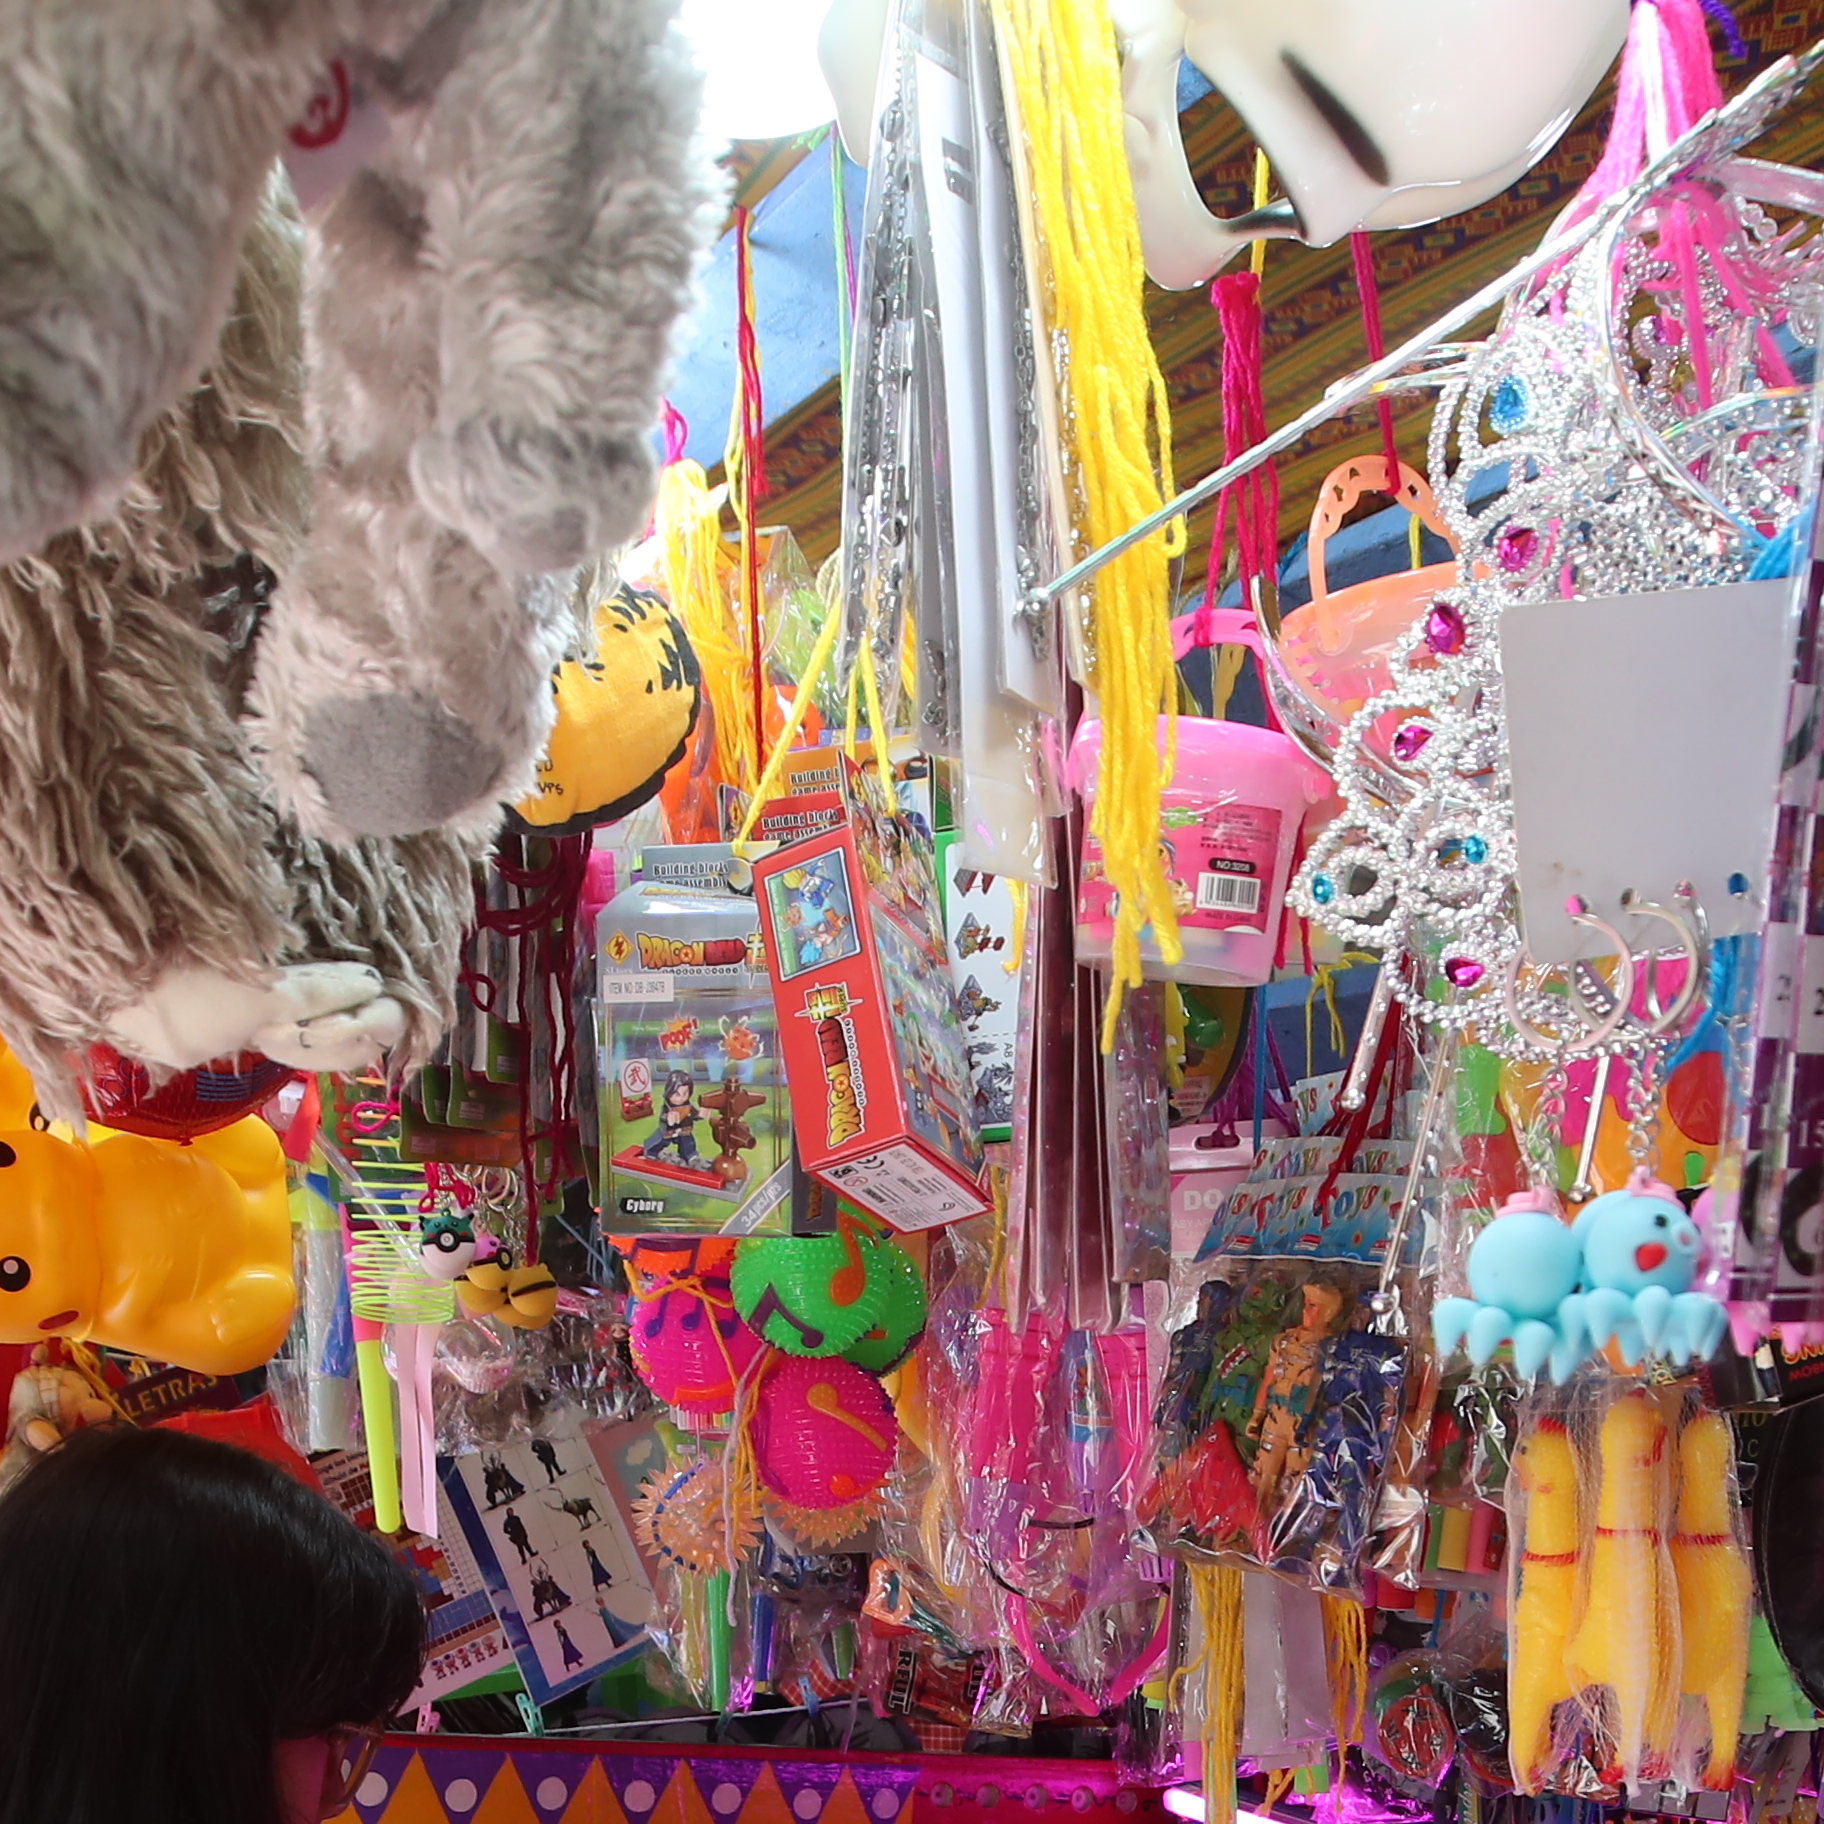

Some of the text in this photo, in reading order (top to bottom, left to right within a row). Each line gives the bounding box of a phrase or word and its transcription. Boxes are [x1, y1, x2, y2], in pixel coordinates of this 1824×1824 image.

[790, 769, 832, 785] Building
[763, 807, 839, 830] Building blocks
[653, 859, 729, 877] Building blocks
[636, 932, 705, 970] DRAGON
[824, 1062, 865, 1149] DRAGON
[625, 1198, 665, 1214] Cyborg
